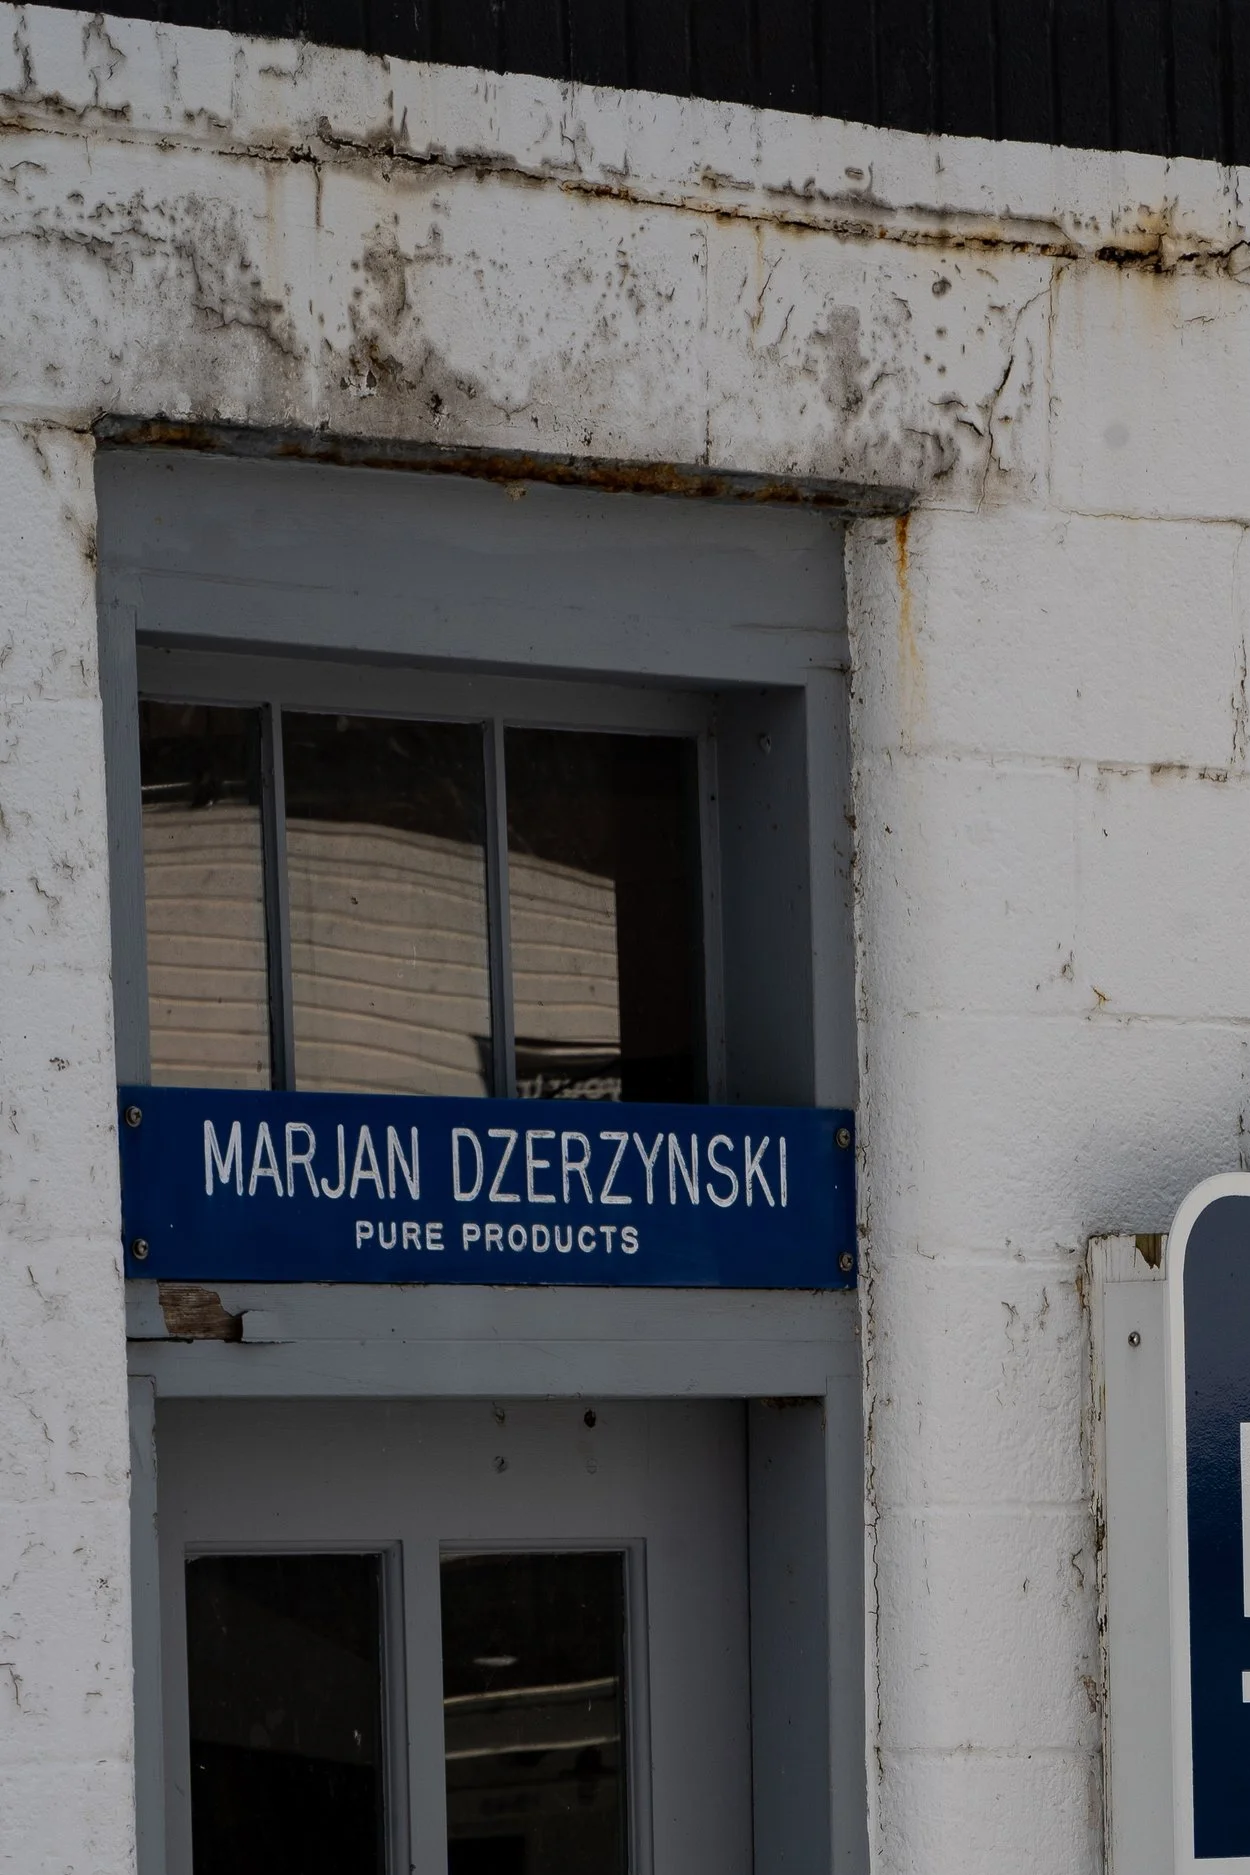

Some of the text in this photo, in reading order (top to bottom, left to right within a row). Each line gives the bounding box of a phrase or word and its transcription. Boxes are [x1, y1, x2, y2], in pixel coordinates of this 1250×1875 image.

[203, 1119, 788, 1208] MARJAN DZERZYNSKI
[355, 1220, 639, 1255] PURE PRODUCTS
